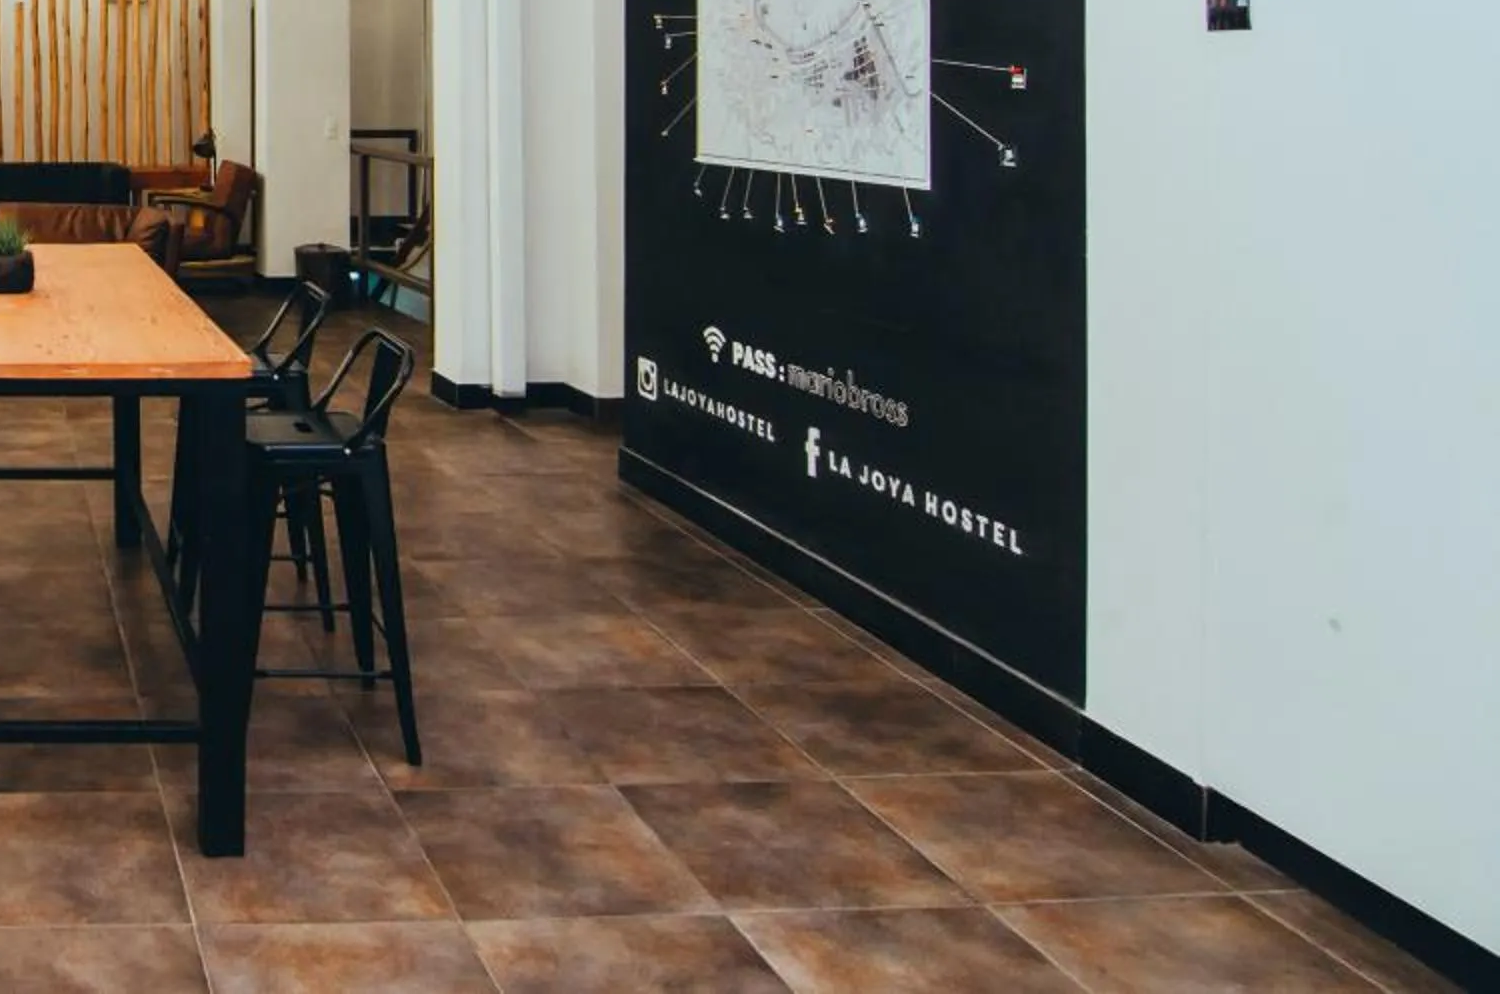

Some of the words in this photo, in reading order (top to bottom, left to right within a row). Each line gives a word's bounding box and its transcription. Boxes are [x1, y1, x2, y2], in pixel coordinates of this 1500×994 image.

[663, 377, 776, 443] LAJOYAHOSTEL
[786, 362, 910, 428] mariobross
[828, 450, 853, 480] LA
[859, 463, 916, 508] JOYA
[924, 490, 1025, 556] HOSTEL
